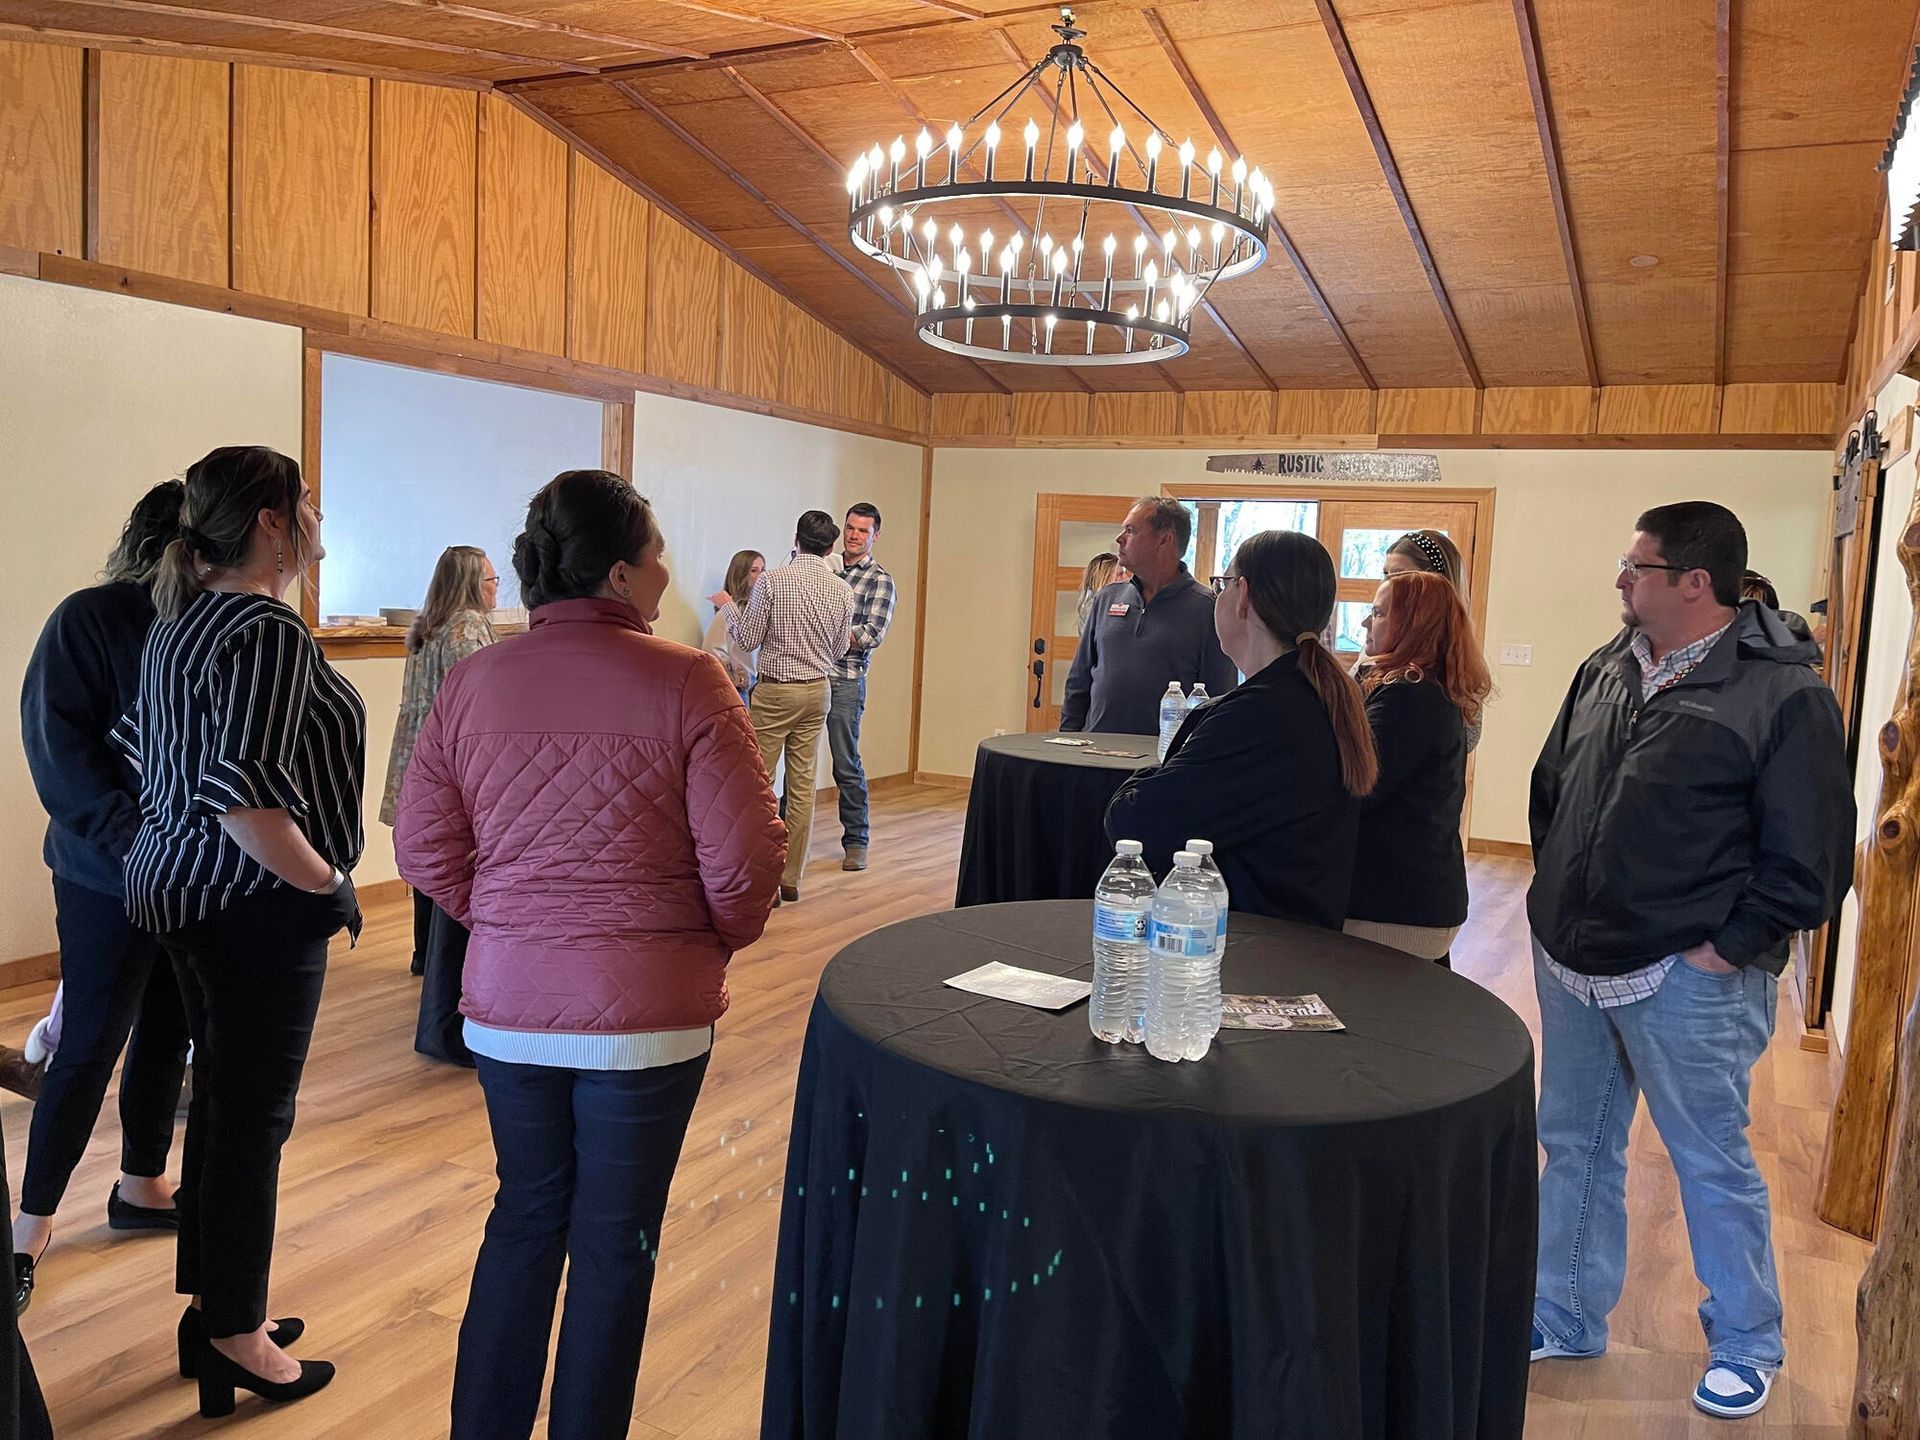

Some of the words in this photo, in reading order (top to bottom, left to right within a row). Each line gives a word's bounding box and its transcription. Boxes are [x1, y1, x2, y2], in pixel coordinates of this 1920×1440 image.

[1278, 453, 1324, 474] RUSTIC
[1222, 1006, 1253, 1014] RID
[1257, 1002, 1324, 1016] RUSTIC
